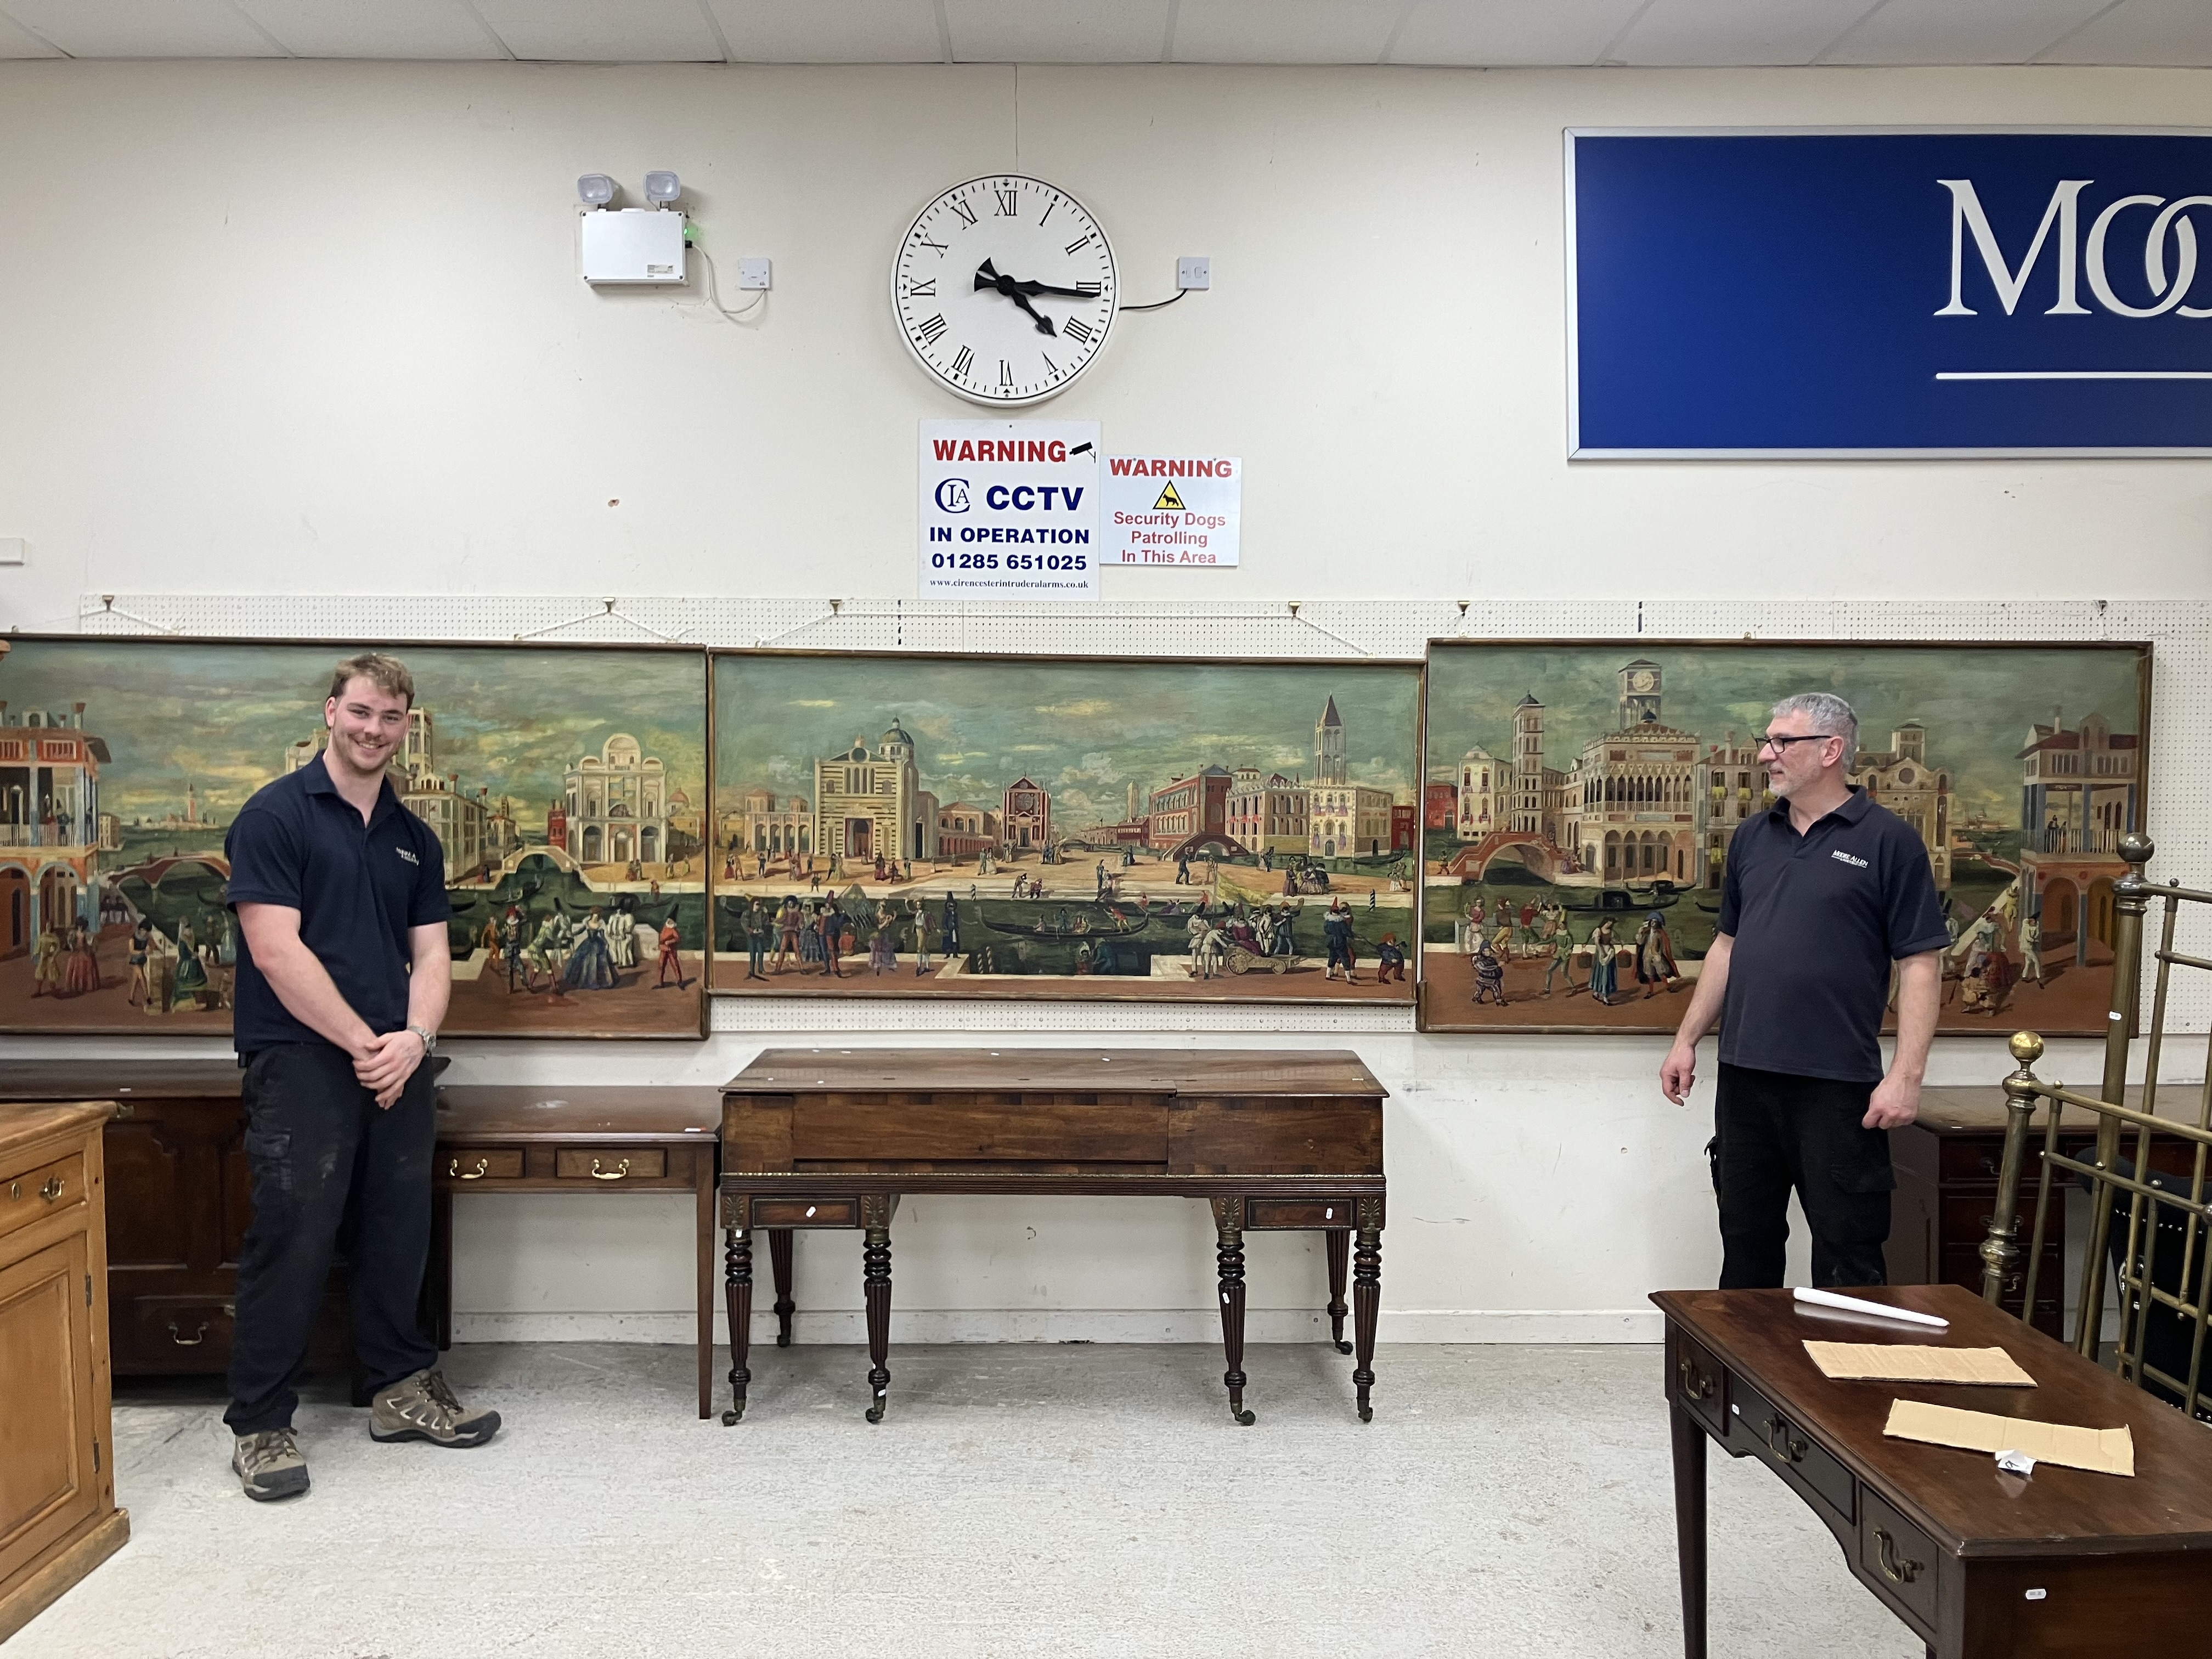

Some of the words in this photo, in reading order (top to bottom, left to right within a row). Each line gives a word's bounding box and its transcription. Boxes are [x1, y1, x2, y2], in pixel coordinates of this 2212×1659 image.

[950, 199, 978, 230] XI
[994, 190, 1018, 216] XII
[1039, 202, 1055, 227] I
[920, 232, 949, 258] X
[1065, 235, 1090, 256] II
[910, 278, 935, 297] IX
[918, 313, 949, 346] VIII
[951, 345, 975, 376] VII
[1041, 351, 1059, 375] V
[1000, 360, 1013, 386] VI
[933, 439, 1067, 462] WARNING
[1109, 458, 1232, 478] WARNING
[986, 485, 1084, 511] CCTV
[1114, 511, 1180, 528] Security
[1185, 512, 1226, 529] Dogs
[930, 527, 952, 542] IN
[960, 527, 1090, 544] OPERATION
[1131, 531, 1207, 548] Patrolling
[932, 553, 999, 569] 01285
[1006, 555, 1087, 570] 651025
[1122, 549, 1136, 562] In
[1141, 550, 1175, 563] This
[1179, 550, 1217, 563] Area
[929, 579, 1089, 589] www.cirencesterintruderalarms.co.uk
